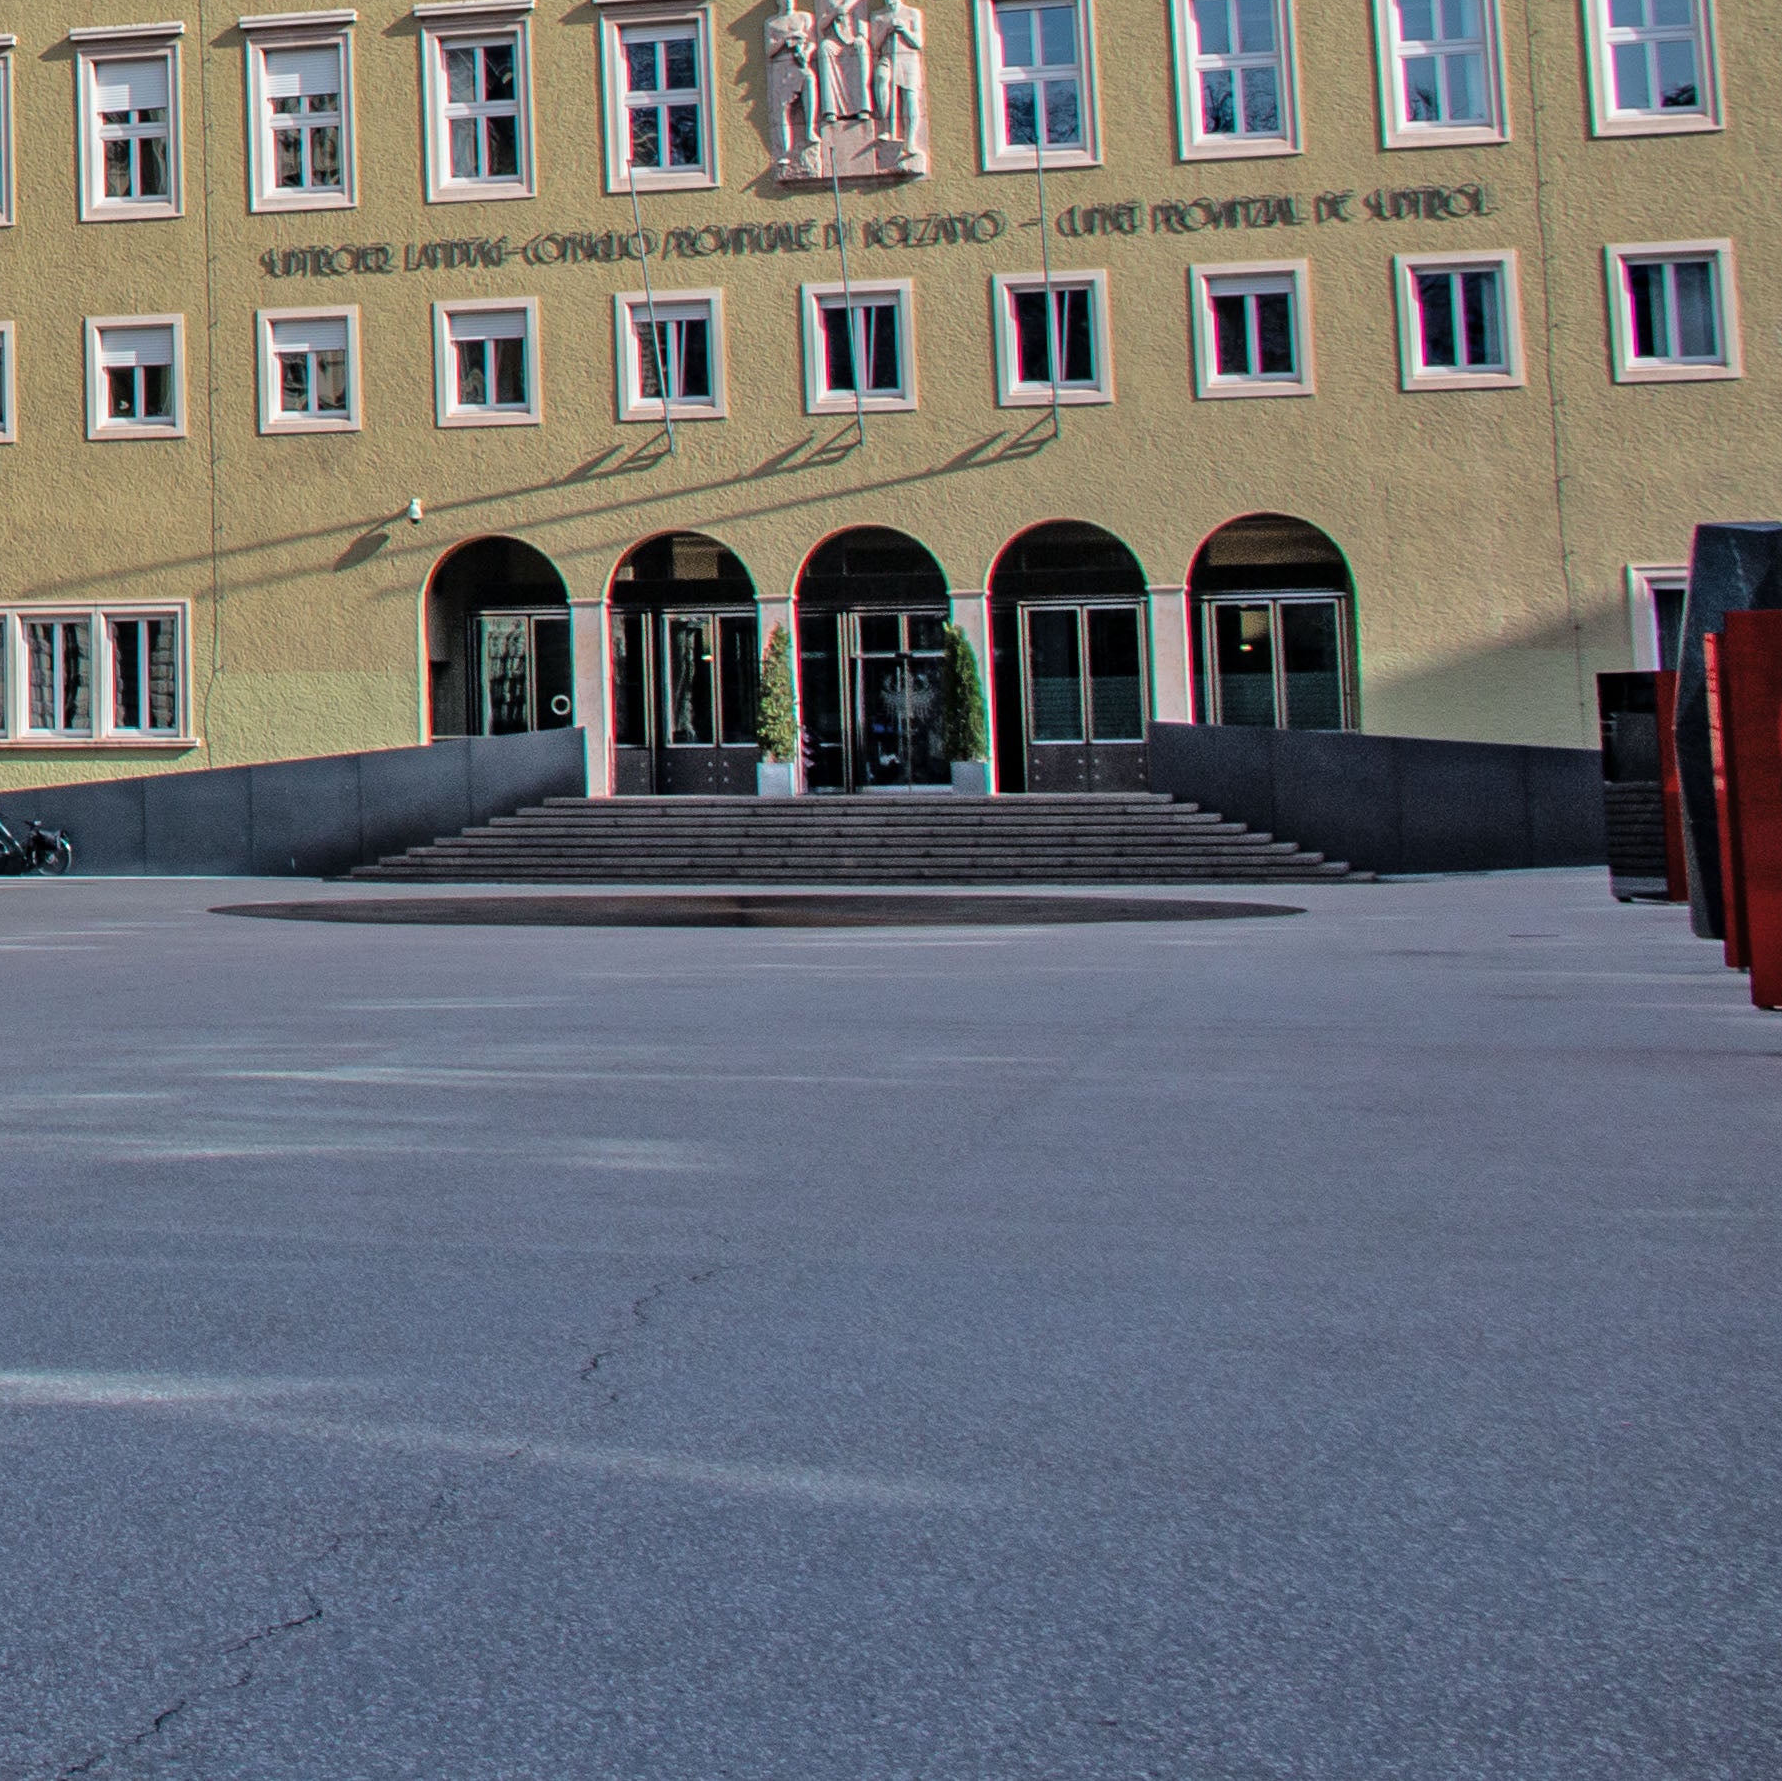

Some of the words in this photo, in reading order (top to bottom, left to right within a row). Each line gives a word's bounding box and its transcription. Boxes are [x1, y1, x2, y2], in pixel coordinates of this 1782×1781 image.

[522, 227, 658, 266] CONSIGLIO
[660, 219, 820, 261] PROVINCIALE
[862, 209, 1007, 249] BOLZANO
